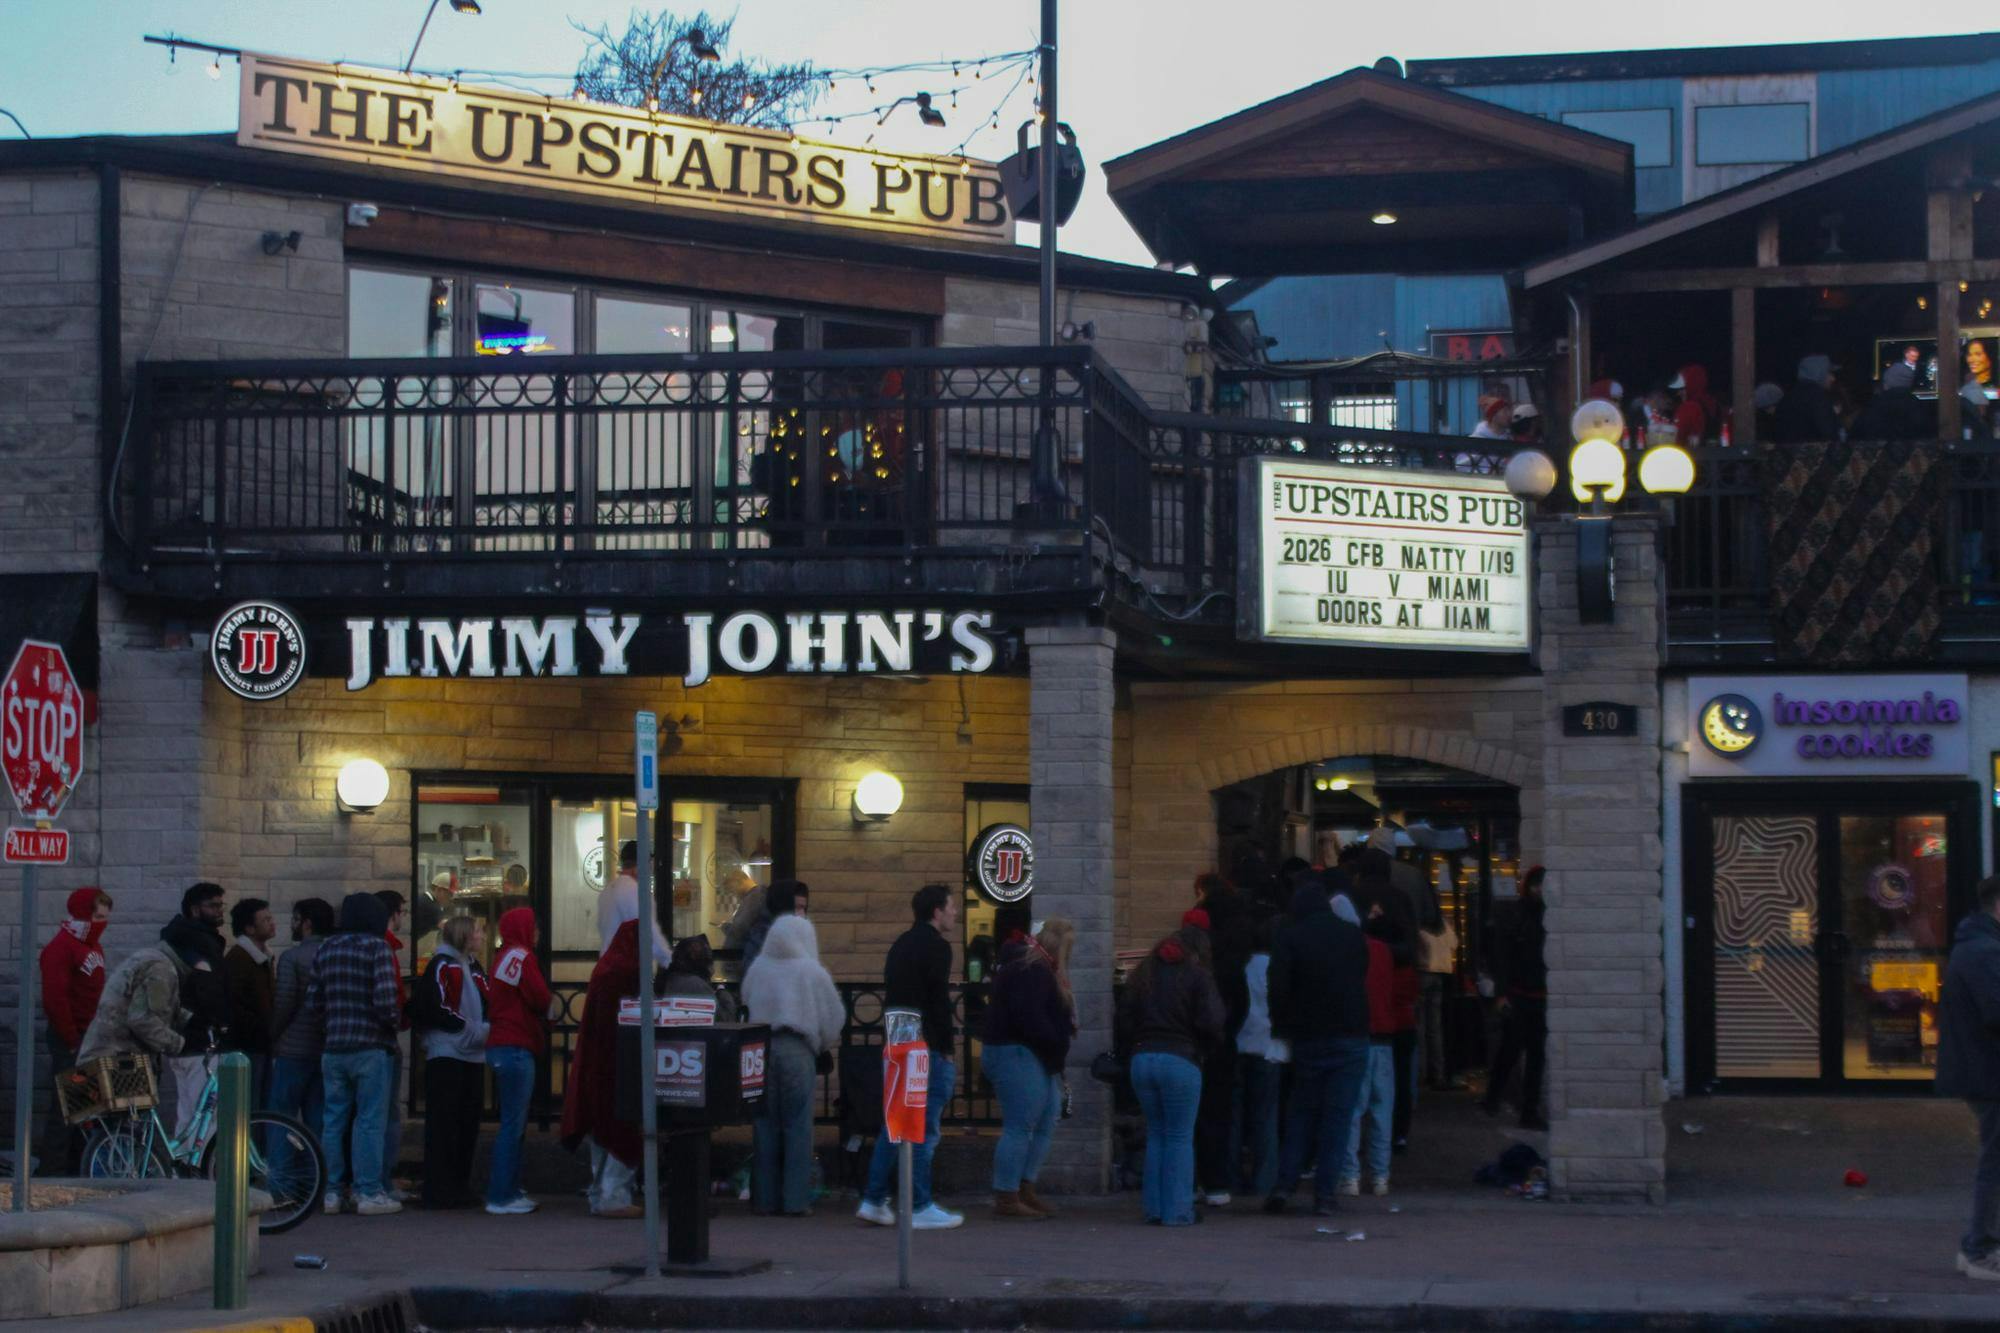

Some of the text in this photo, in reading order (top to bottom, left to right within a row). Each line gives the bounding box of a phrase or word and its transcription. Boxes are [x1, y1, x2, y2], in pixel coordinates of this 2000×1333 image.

[254, 72, 1007, 228] THE UPSTAIRS PUB
[1273, 481, 1282, 511] THE
[1285, 483, 1522, 527] UPSTAIRS PUB
[1283, 538, 1331, 563] 2026
[1347, 542, 1384, 567] CFB
[1401, 545, 1467, 572] NATTY
[1328, 569, 1489, 601] IU V MIAMI
[218, 607, 299, 652] JIMMY JOHN'S
[1318, 599, 1490, 630] DOORS AT 11AM
[238, 630, 280, 675] JJ
[345, 609, 995, 691] JIMMY JOHN'S
[219, 656, 298, 693] GOURMET SANDWICHES
[1582, 711, 1618, 730] 430
[1773, 690, 1961, 725] insomnia
[6, 695, 78, 764] STOP
[1796, 723, 1934, 760] cookies
[11, 836, 64, 857] ALL WAY
[984, 834, 1010, 861] JIMMY
[984, 870, 1005, 896] GOURMET
[996, 850, 1024, 884] JJ
